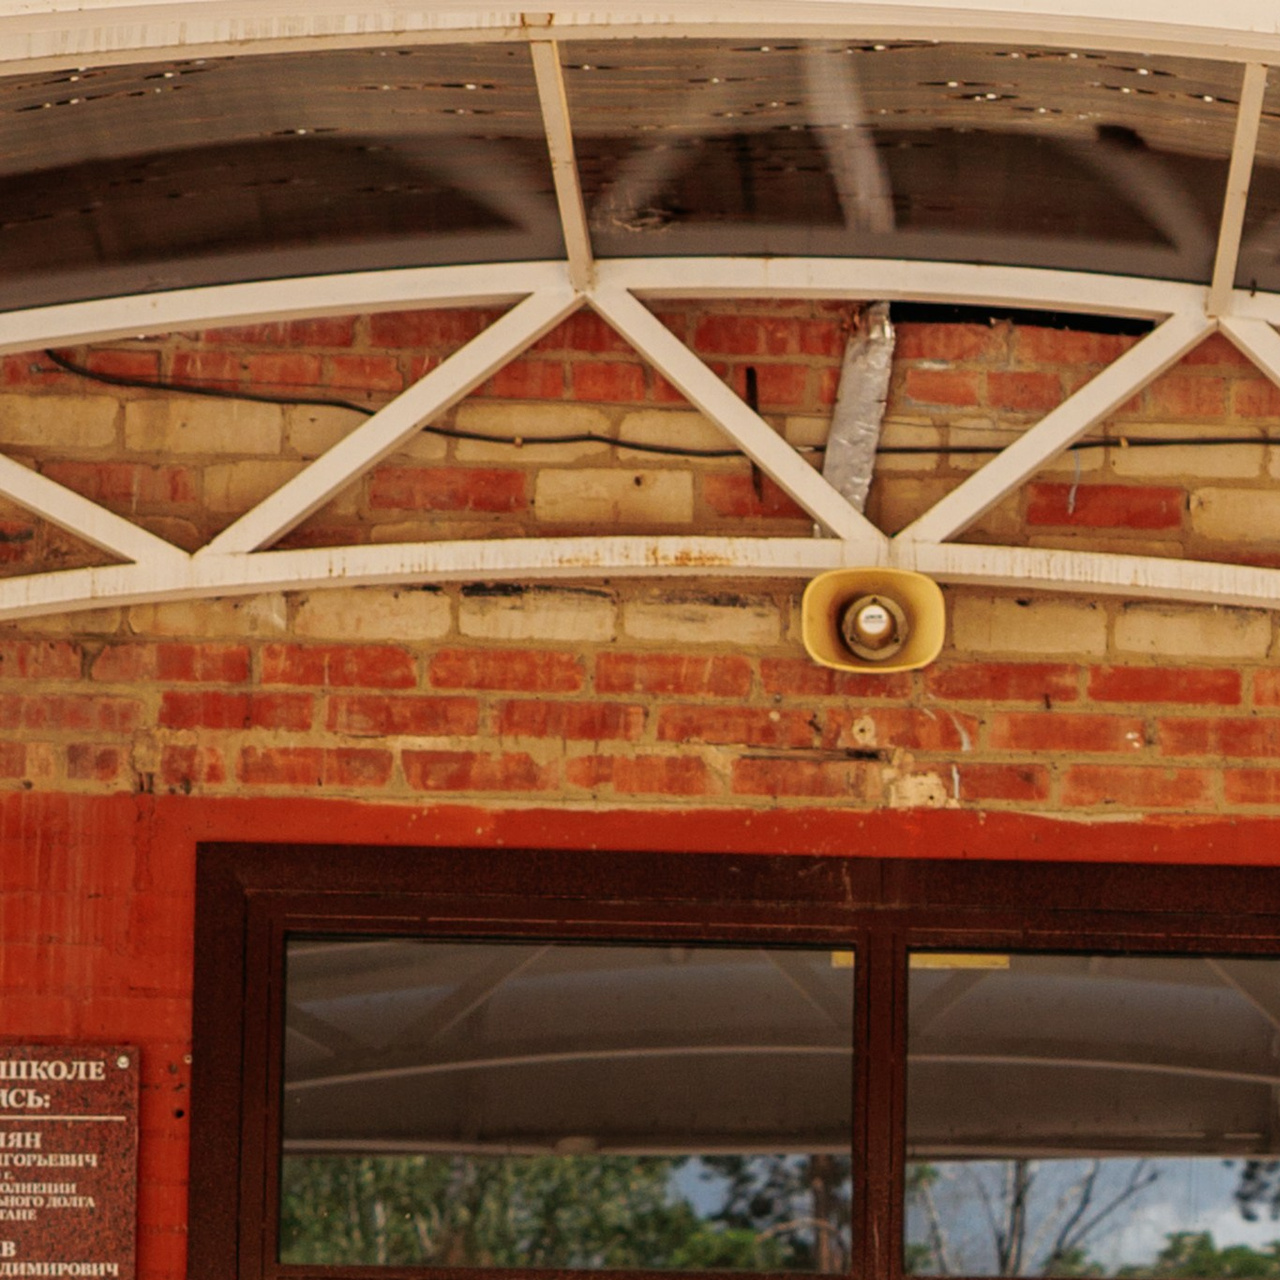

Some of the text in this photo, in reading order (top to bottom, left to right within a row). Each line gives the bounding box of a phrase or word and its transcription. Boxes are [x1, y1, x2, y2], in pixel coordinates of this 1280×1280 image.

[0, 1060, 106, 1081] ШКОЛЕ
[46, 1196, 96, 1209] ДОЛГА
[0, 1240, 17, 1258] В
